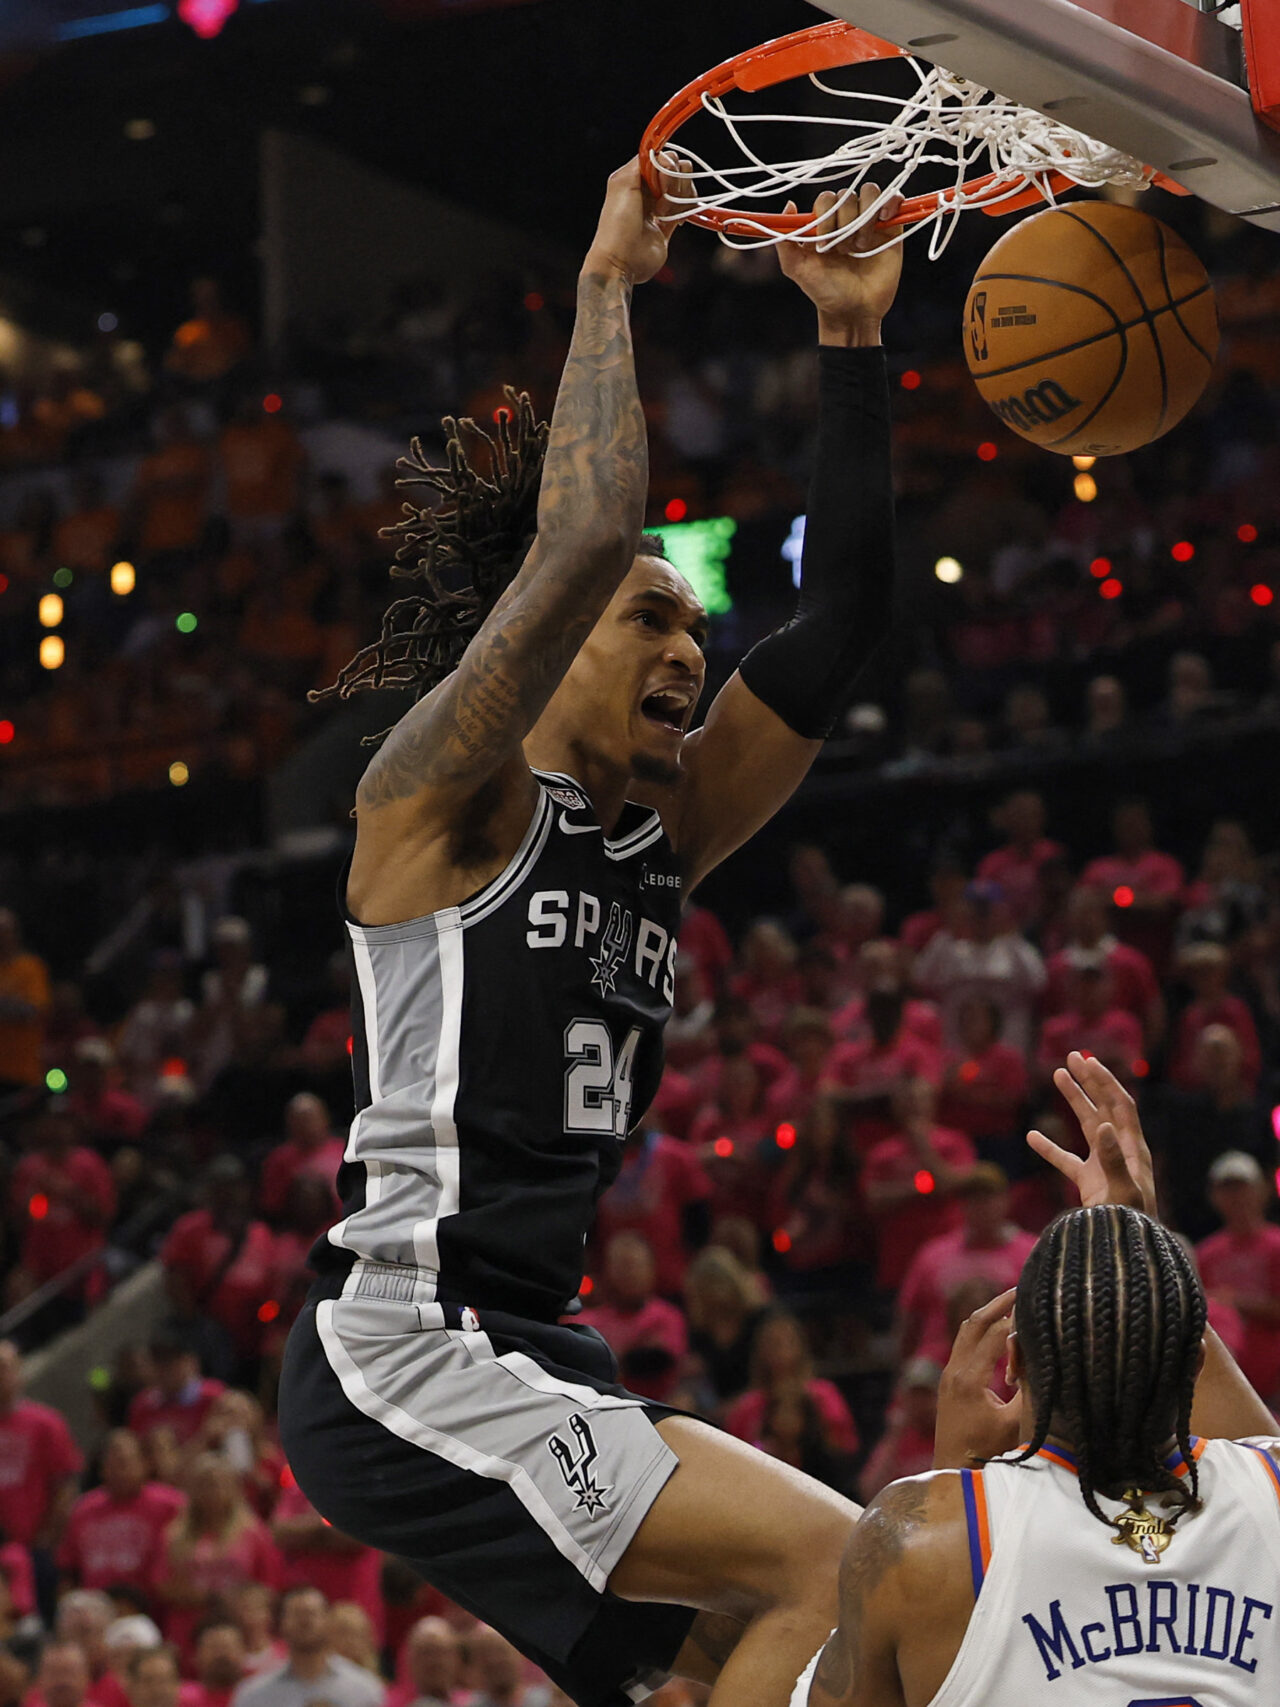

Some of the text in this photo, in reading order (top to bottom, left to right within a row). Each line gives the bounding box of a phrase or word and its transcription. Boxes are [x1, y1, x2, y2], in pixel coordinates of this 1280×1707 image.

[643, 871, 682, 889] LEDGE
[562, 1015, 644, 1141] 24
[1021, 1580, 1274, 1682] McBRIDE
